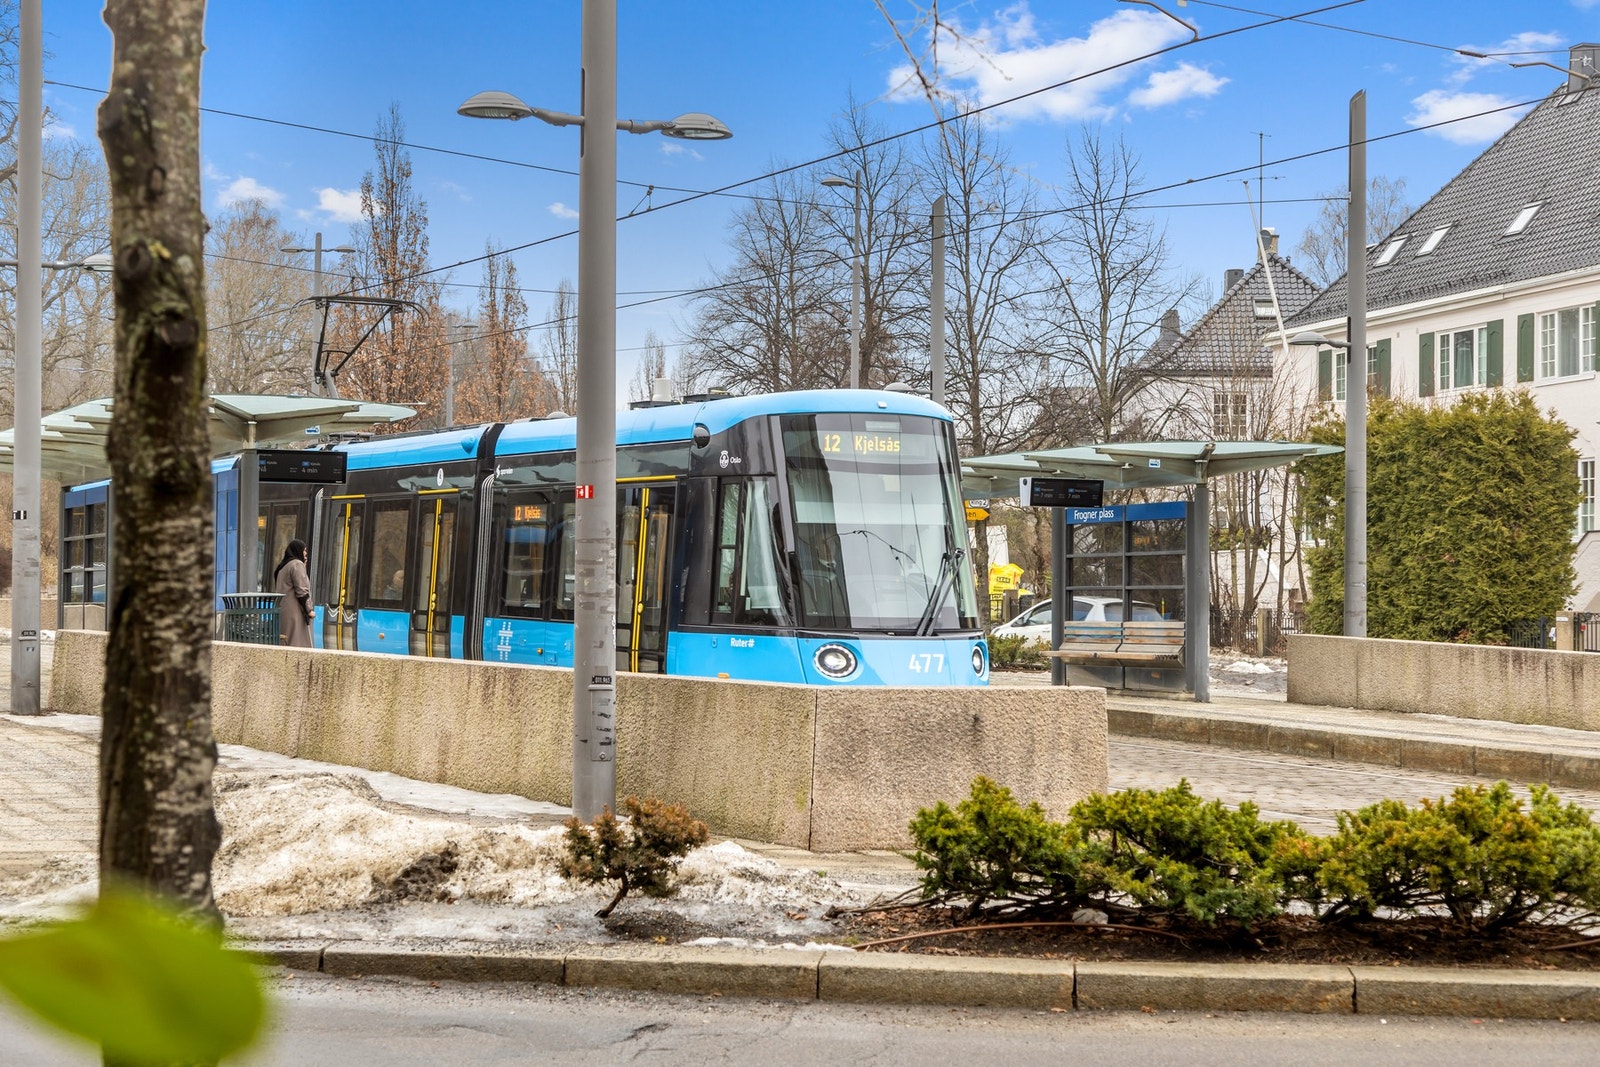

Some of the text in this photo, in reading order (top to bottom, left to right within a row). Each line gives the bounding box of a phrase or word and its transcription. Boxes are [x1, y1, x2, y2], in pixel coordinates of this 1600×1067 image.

[824, 434, 900, 454] 12 Kjelsås
[730, 456, 741, 464] Oslo
[1074, 508, 1114, 522] Frogner plass
[730, 637, 755, 648] Ruter#
[908, 653, 945, 674] 477
